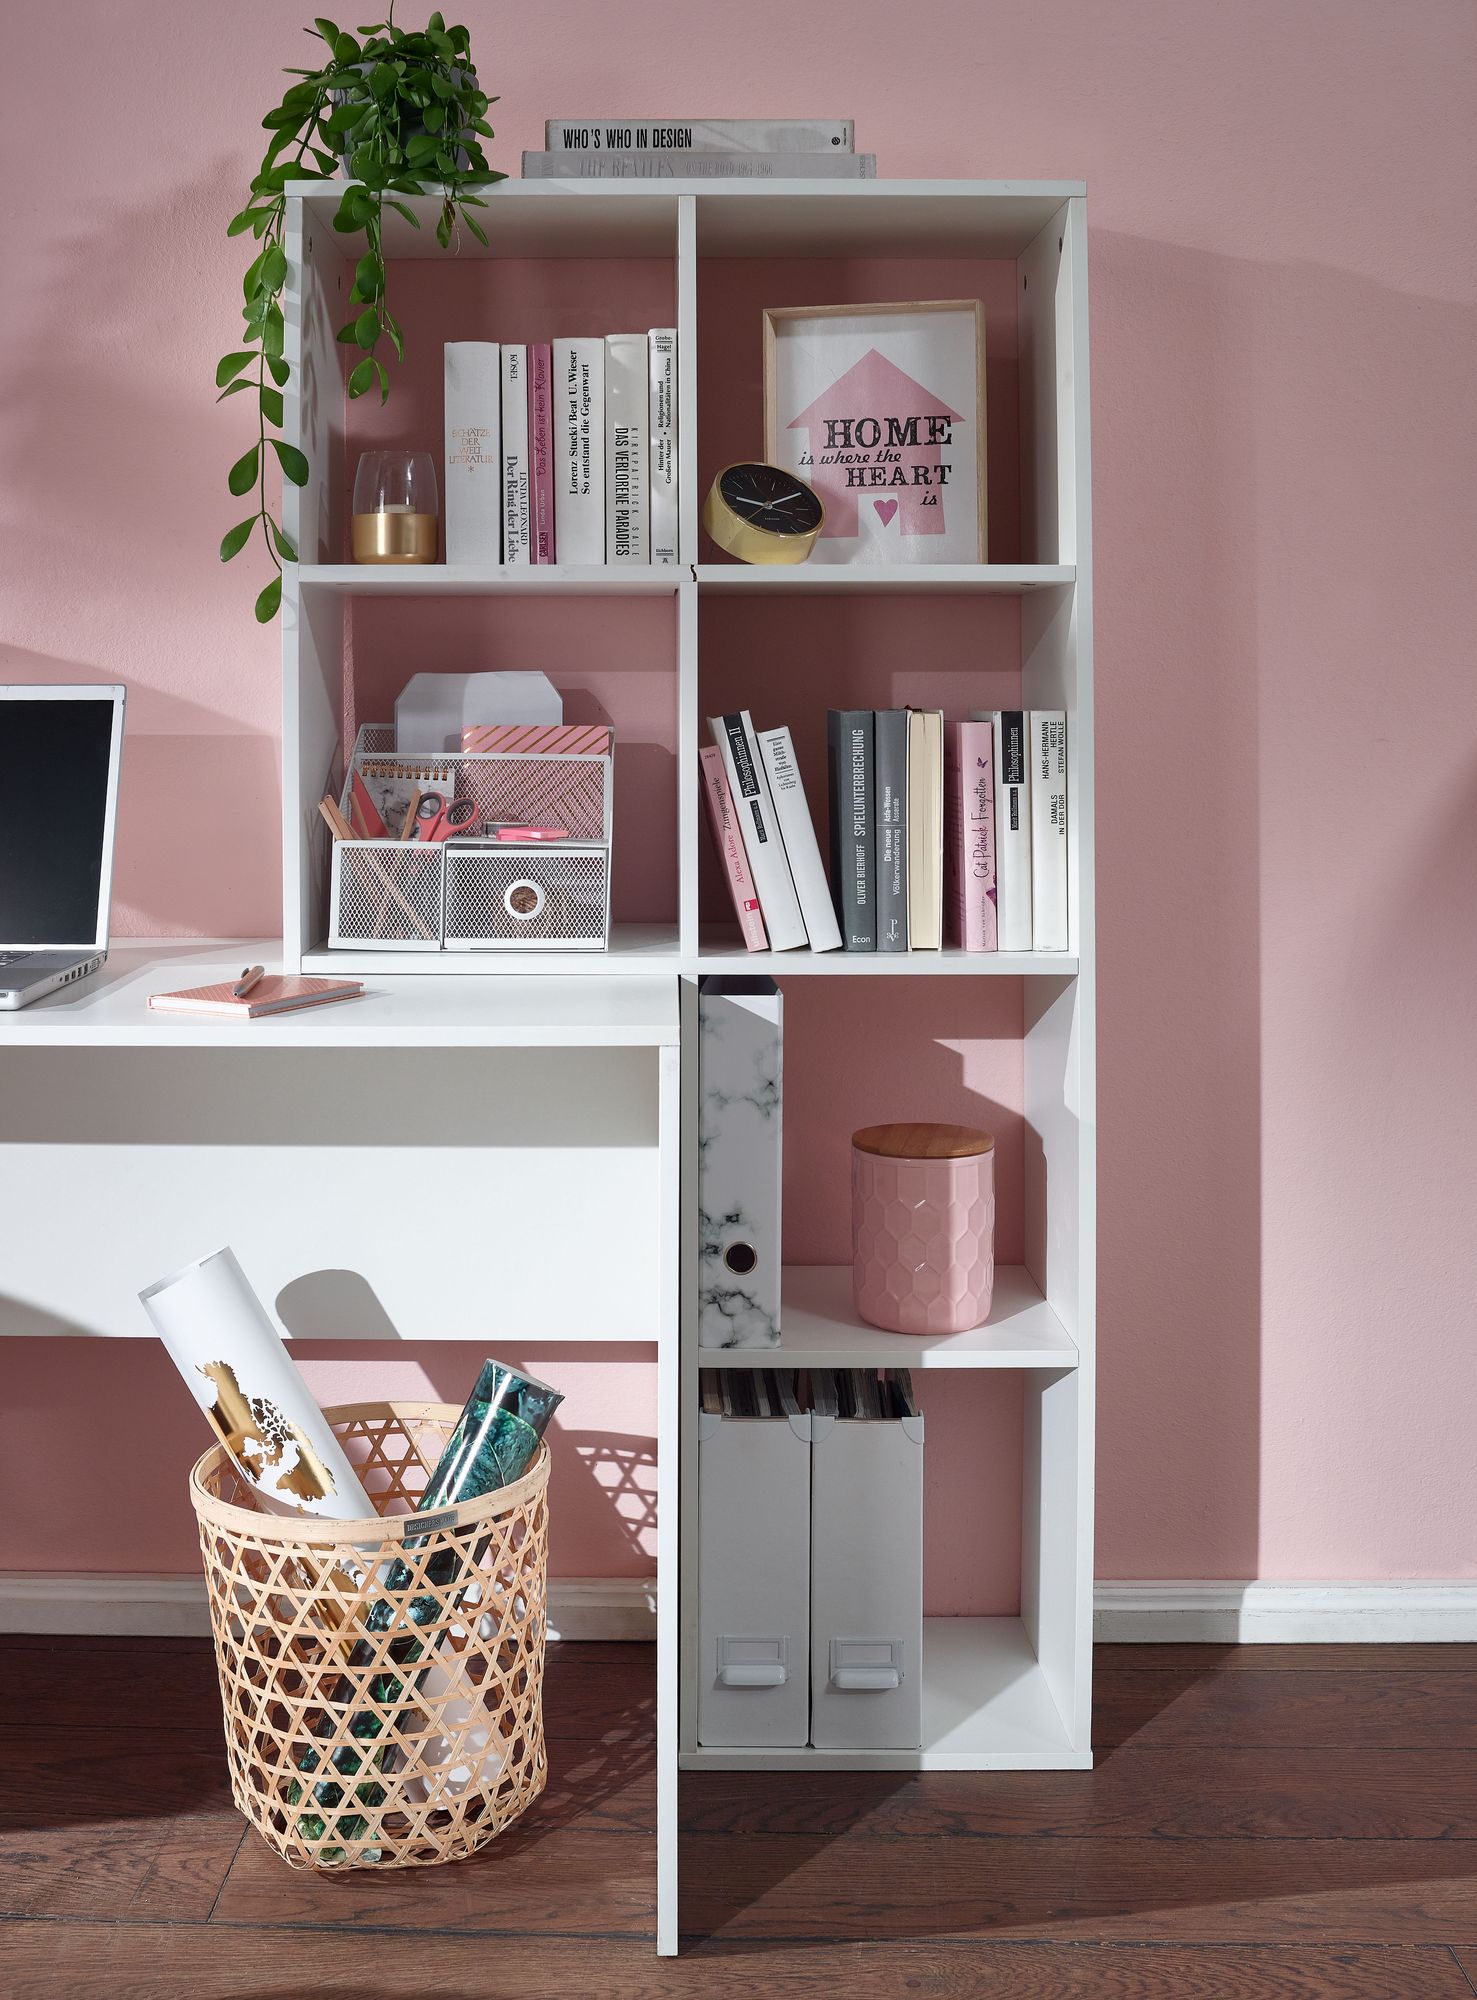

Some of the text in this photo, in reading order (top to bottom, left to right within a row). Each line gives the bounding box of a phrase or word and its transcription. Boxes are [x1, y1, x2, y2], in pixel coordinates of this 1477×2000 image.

[563, 128, 692, 149] WHO'S WHO IN DESIGN
[534, 359, 547, 393] Klavier
[568, 350, 578, 382] Wieser
[535, 393, 546, 414] kein
[538, 414, 546, 426] ist
[658, 395, 666, 428] Religionen
[664, 384, 672, 428] Nationalitäten
[461, 437, 481, 446] DER
[535, 426, 547, 456] Leben
[568, 400, 579, 457] Stucki/Beat
[580, 363, 592, 495] So entstand die Gegenwart
[823, 415, 952, 449] HOME
[449, 454, 494, 464] LITERATUR
[458, 446, 482, 455] WELT
[798, 449, 902, 465] is where the
[568, 460, 579, 495] Lorenz
[631, 427, 639, 513] KIRKPATRICK
[845, 465, 952, 488] HEART
[615, 427, 629, 556] DAS VERLORENE PARADIES
[920, 491, 938, 506] is
[507, 456, 519, 562] Der Ring der Liebe
[520, 501, 528, 545] LEONARD
[538, 532, 549, 558] CARLSEN
[734, 736, 757, 796] Philosophinnen
[1008, 727, 1019, 783] Philosophinnen
[852, 729, 866, 905] OLIVER BIERHOFF SPIELUNTERBRECHUNG
[1050, 794, 1058, 824] DAMALS
[712, 777, 745, 884] Alexa Adore Zungenspiele
[970, 776, 993, 879] Cat Patrick Forgotten
[1058, 826, 1065, 836] IN
[884, 829, 892, 862] Die neue
[893, 829, 902, 895] Völkerwanderung
[852, 935, 871, 944] Econ
